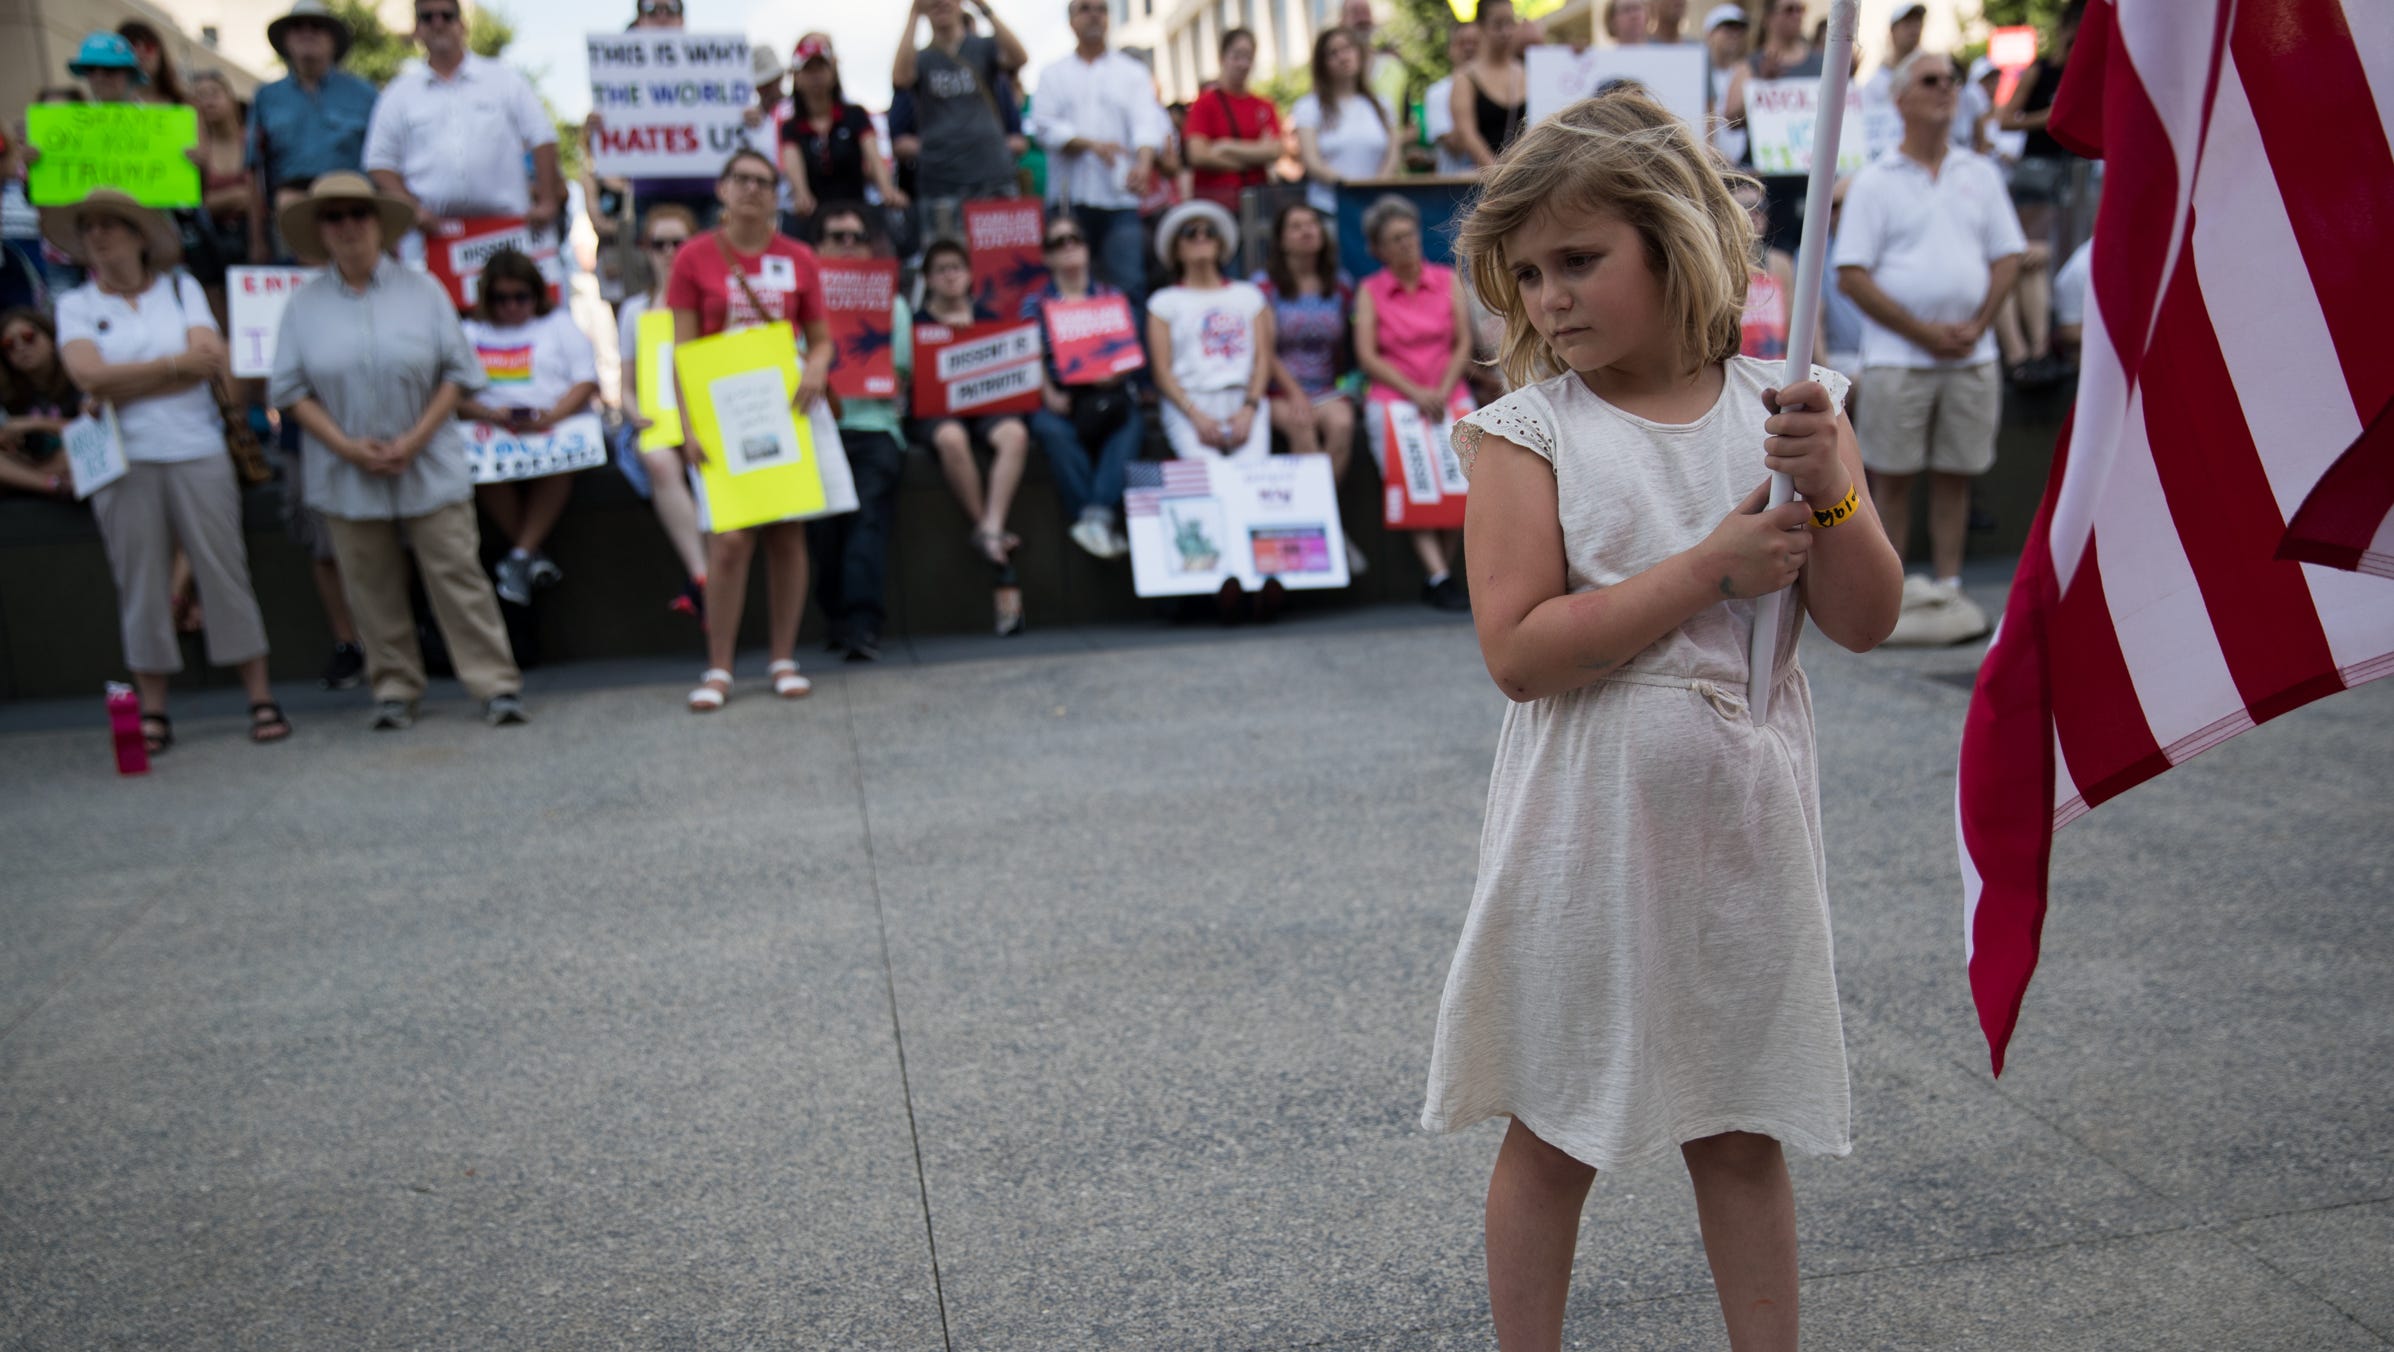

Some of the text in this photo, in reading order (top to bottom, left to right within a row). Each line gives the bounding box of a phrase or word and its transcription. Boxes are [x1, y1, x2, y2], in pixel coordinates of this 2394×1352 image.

[588, 40, 747, 67] THIS IS WHY
[593, 81, 751, 107] THE WORLD
[600, 123, 700, 155] HATES
[57, 160, 168, 188] TRUMP
